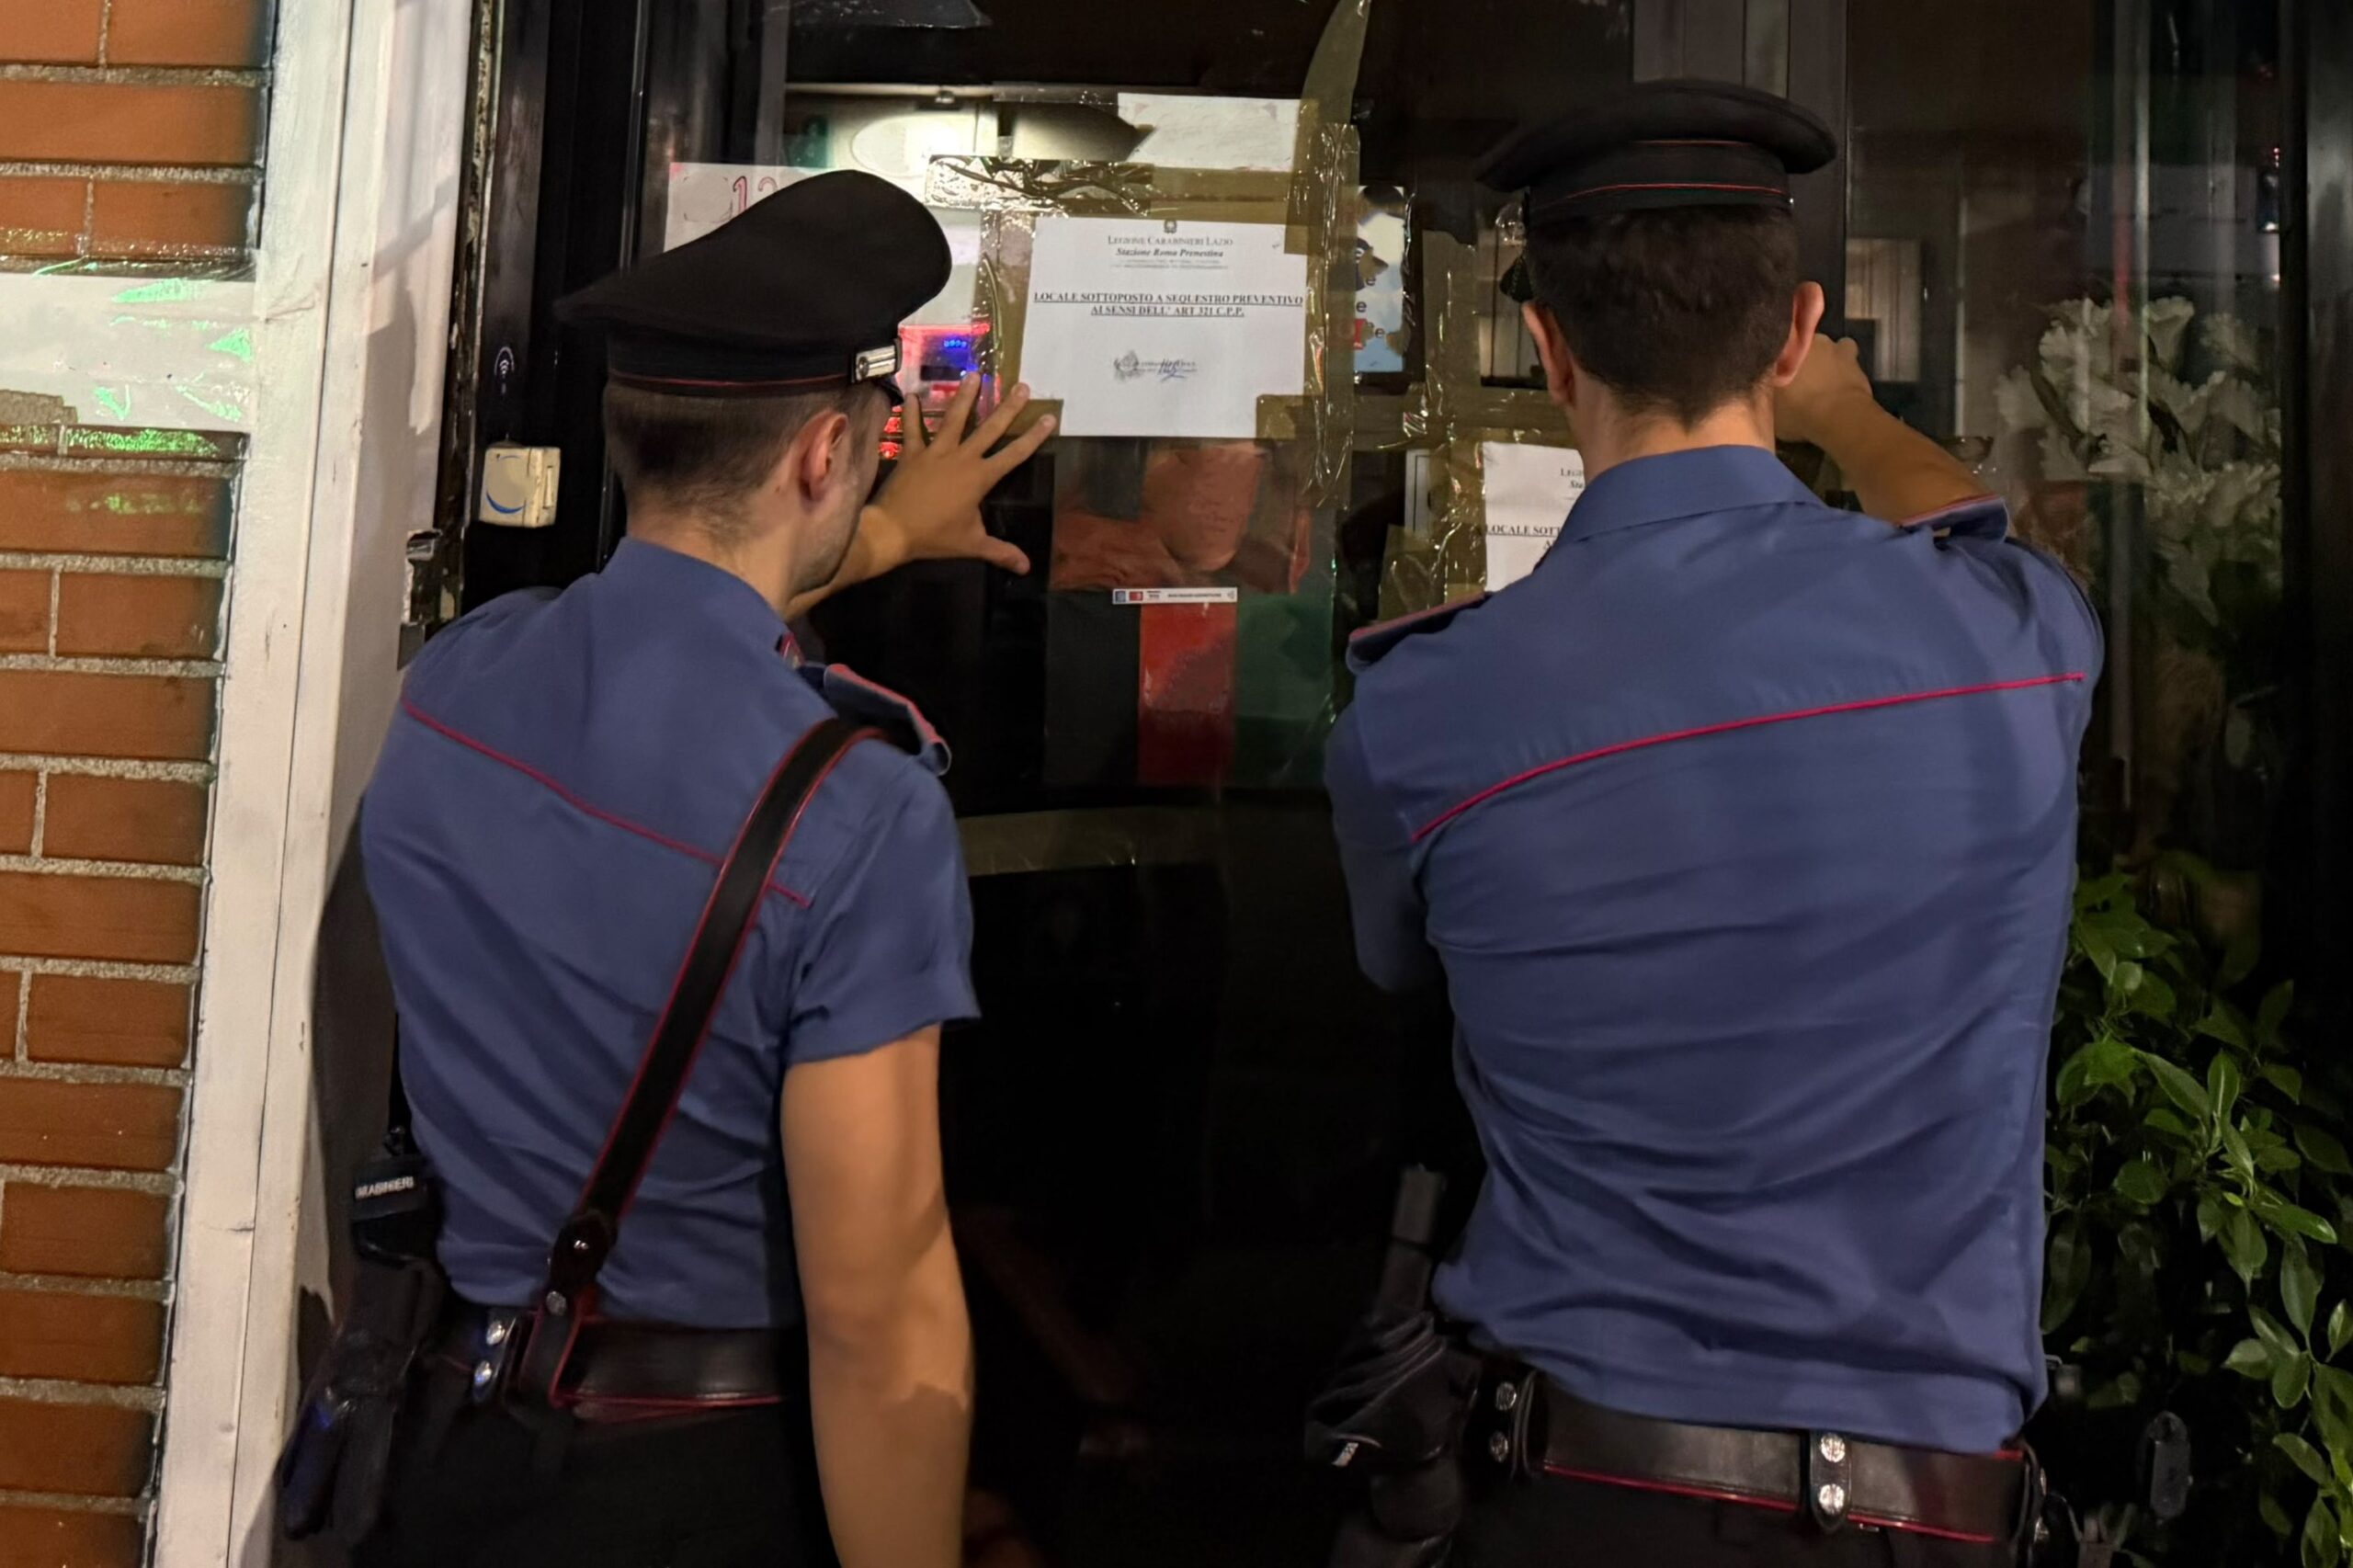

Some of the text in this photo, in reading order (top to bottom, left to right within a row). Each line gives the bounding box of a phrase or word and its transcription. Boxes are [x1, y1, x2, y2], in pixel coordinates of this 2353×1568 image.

[1116, 247, 1151, 256] Stazione
[1153, 248, 1177, 256] Roma
[1034, 291, 1077, 302] LOCALE
[1081, 292, 1154, 303] SOTTOPOSTO
[1165, 293, 1231, 305] SEQUESTRO
[1233, 294, 1303, 306] PREVENTIVO
[1105, 305, 1136, 316] SENSI
[1176, 307, 1195, 316] ART
